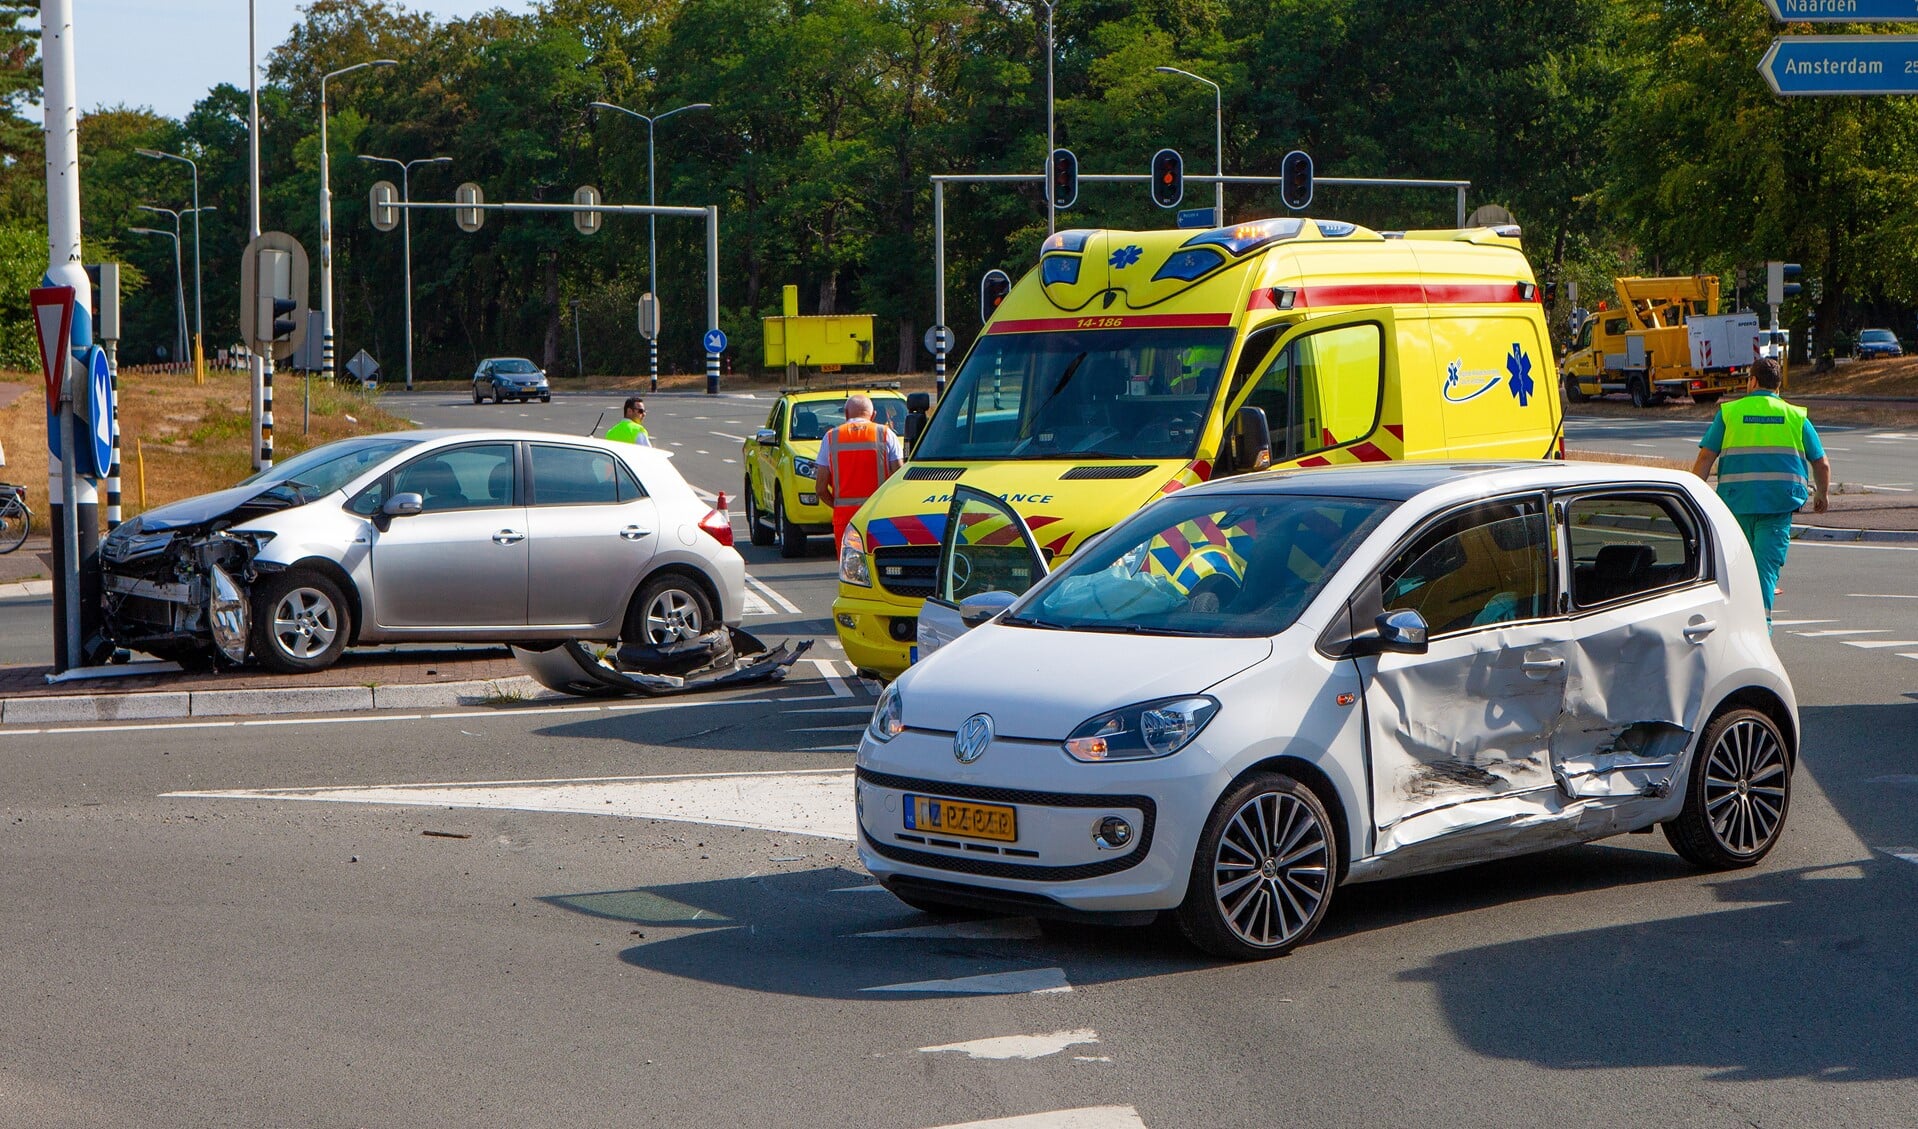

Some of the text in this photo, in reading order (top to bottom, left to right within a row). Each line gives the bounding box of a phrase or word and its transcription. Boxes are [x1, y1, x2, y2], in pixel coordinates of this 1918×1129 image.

[1786, 0, 1856, 12] Naarden
[1785, 58, 1883, 74] Amsterdam
[1077, 318, 1123, 328] 14-186
[922, 493, 1054, 504] AMANCE
